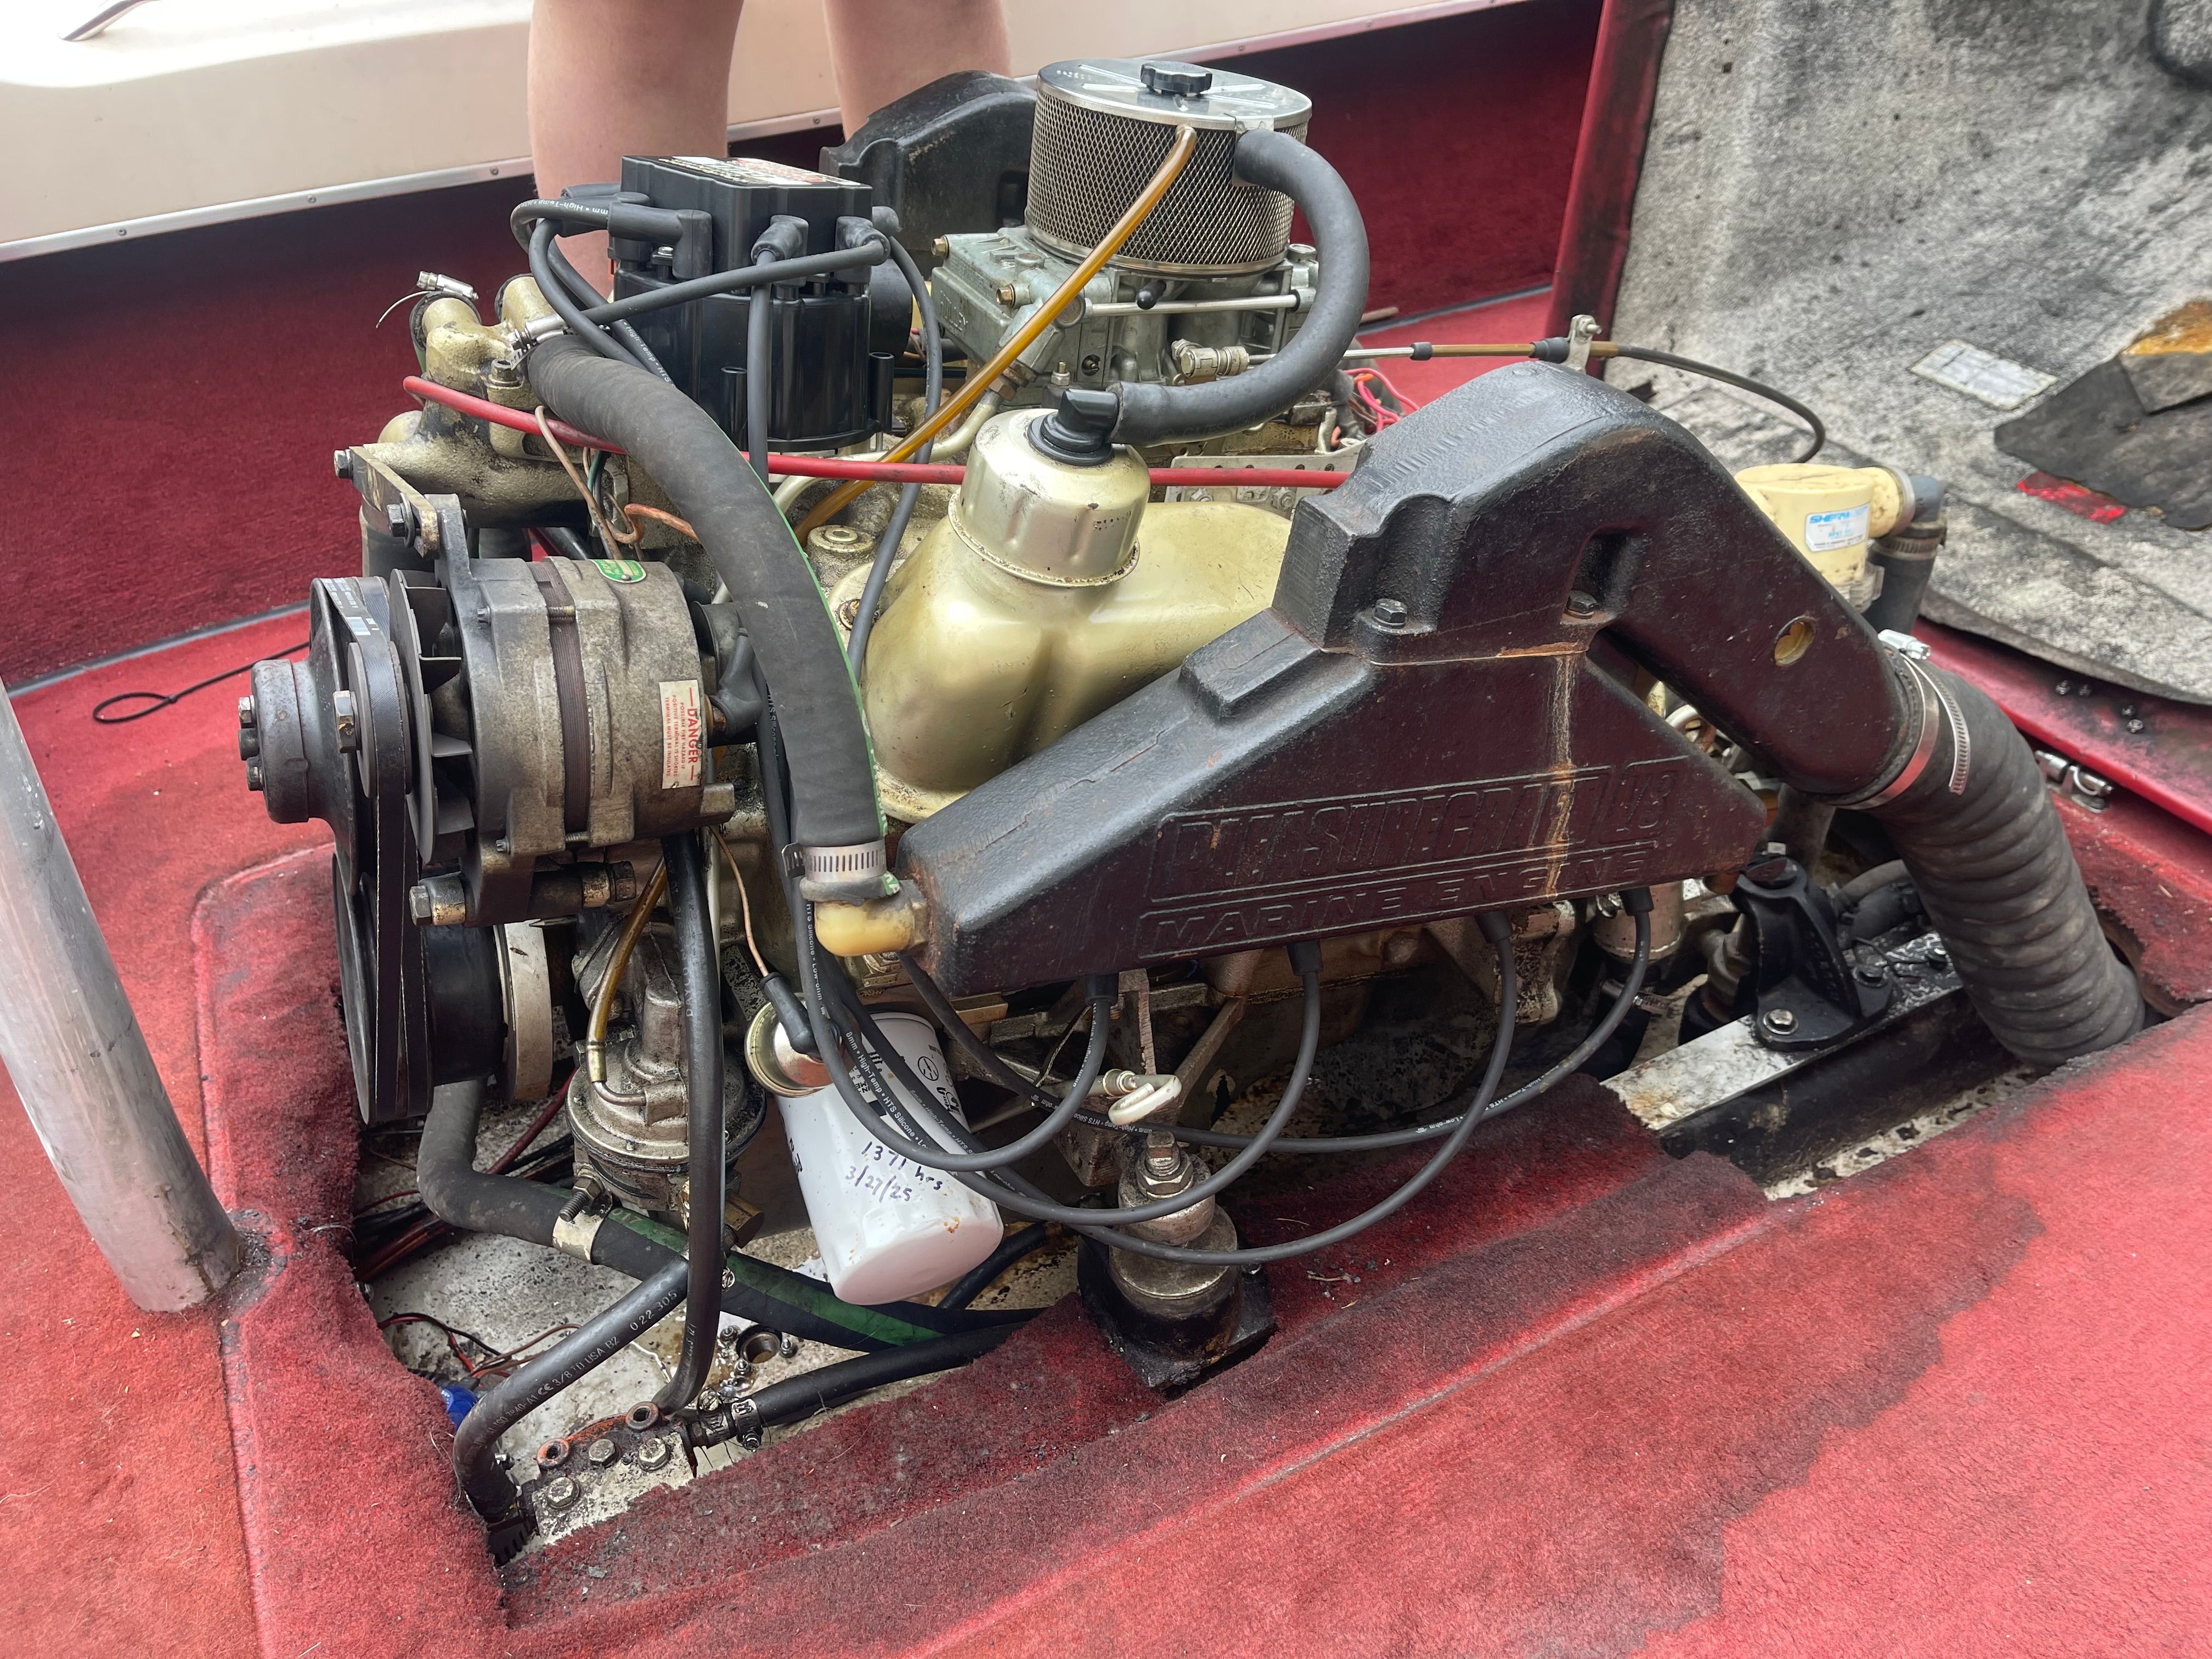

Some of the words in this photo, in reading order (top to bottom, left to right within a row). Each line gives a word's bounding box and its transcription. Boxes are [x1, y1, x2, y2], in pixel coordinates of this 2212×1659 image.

[538, 199, 584, 212] High-Temp
[625, 326, 656, 362] High-Temp
[657, 367, 672, 382] HTS
[687, 708, 699, 764] DANGER
[1154, 887, 1407, 949] MARINE
[1435, 850, 1647, 903] ENGINE
[812, 963, 823, 1001] Low-ohm
[845, 1031, 859, 1051] 8mm
[857, 1053, 883, 1094] High-Temp
[883, 1096, 897, 1113] HTS
[894, 1111, 916, 1138] Silicone
[909, 1089, 923, 1104] 8mm
[924, 1105, 952, 1136] High-Temp
[955, 1137, 969, 1150] HTS
[1074, 1113, 1088, 1122] Silico
[1088, 1118, 1101, 1126] HTS
[1429, 1116, 1460, 1129] Low-ohm
[845, 1165, 912, 1203] 3/27/25
[861, 1141, 907, 1170] 1371
[915, 1165, 943, 1190] hrs
[552, 1370, 573, 1387] 3/8
[585, 1348, 606, 1365] USA
[605, 1335, 620, 1352] B2
[657, 1289, 678, 1312] 305
